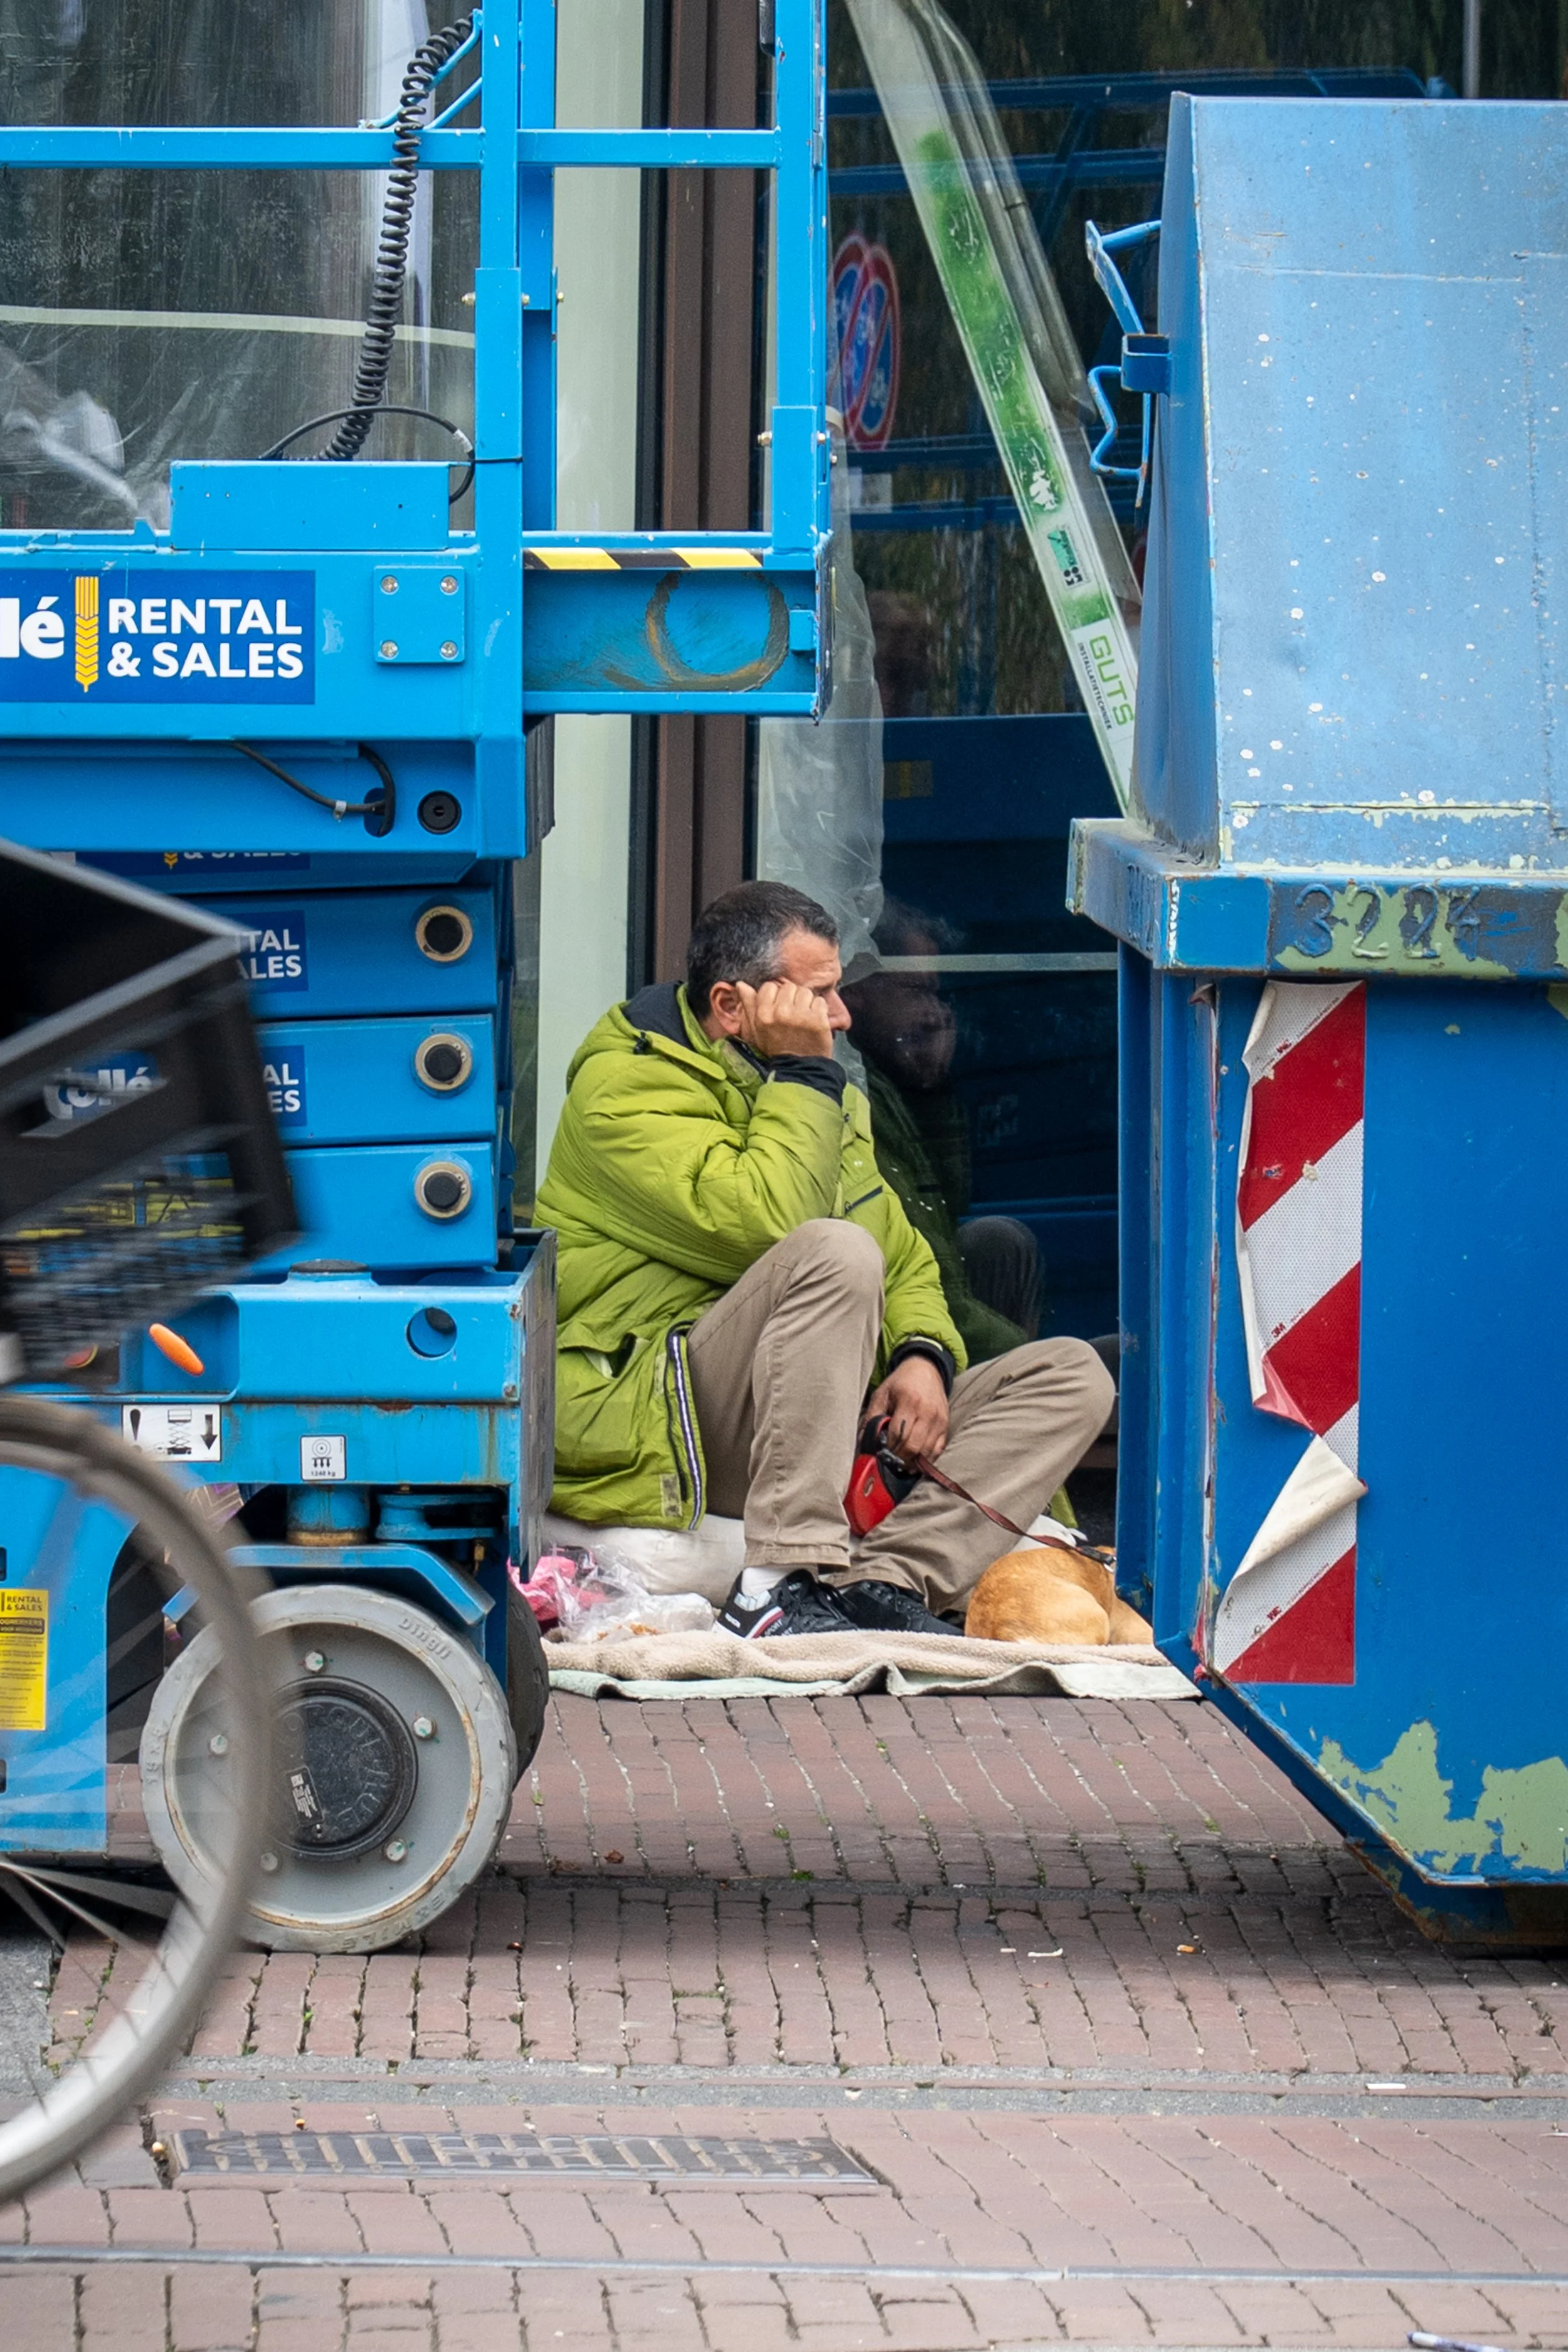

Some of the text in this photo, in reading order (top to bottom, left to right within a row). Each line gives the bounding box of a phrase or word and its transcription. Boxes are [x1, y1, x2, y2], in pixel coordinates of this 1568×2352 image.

[109, 598, 302, 635] RENTAL
[107, 642, 304, 679] & SALES
[1090, 635, 1135, 726] GUTS
[6, 1595, 42, 1604] RENTAL
[398, 1618, 452, 1661] Dingli
